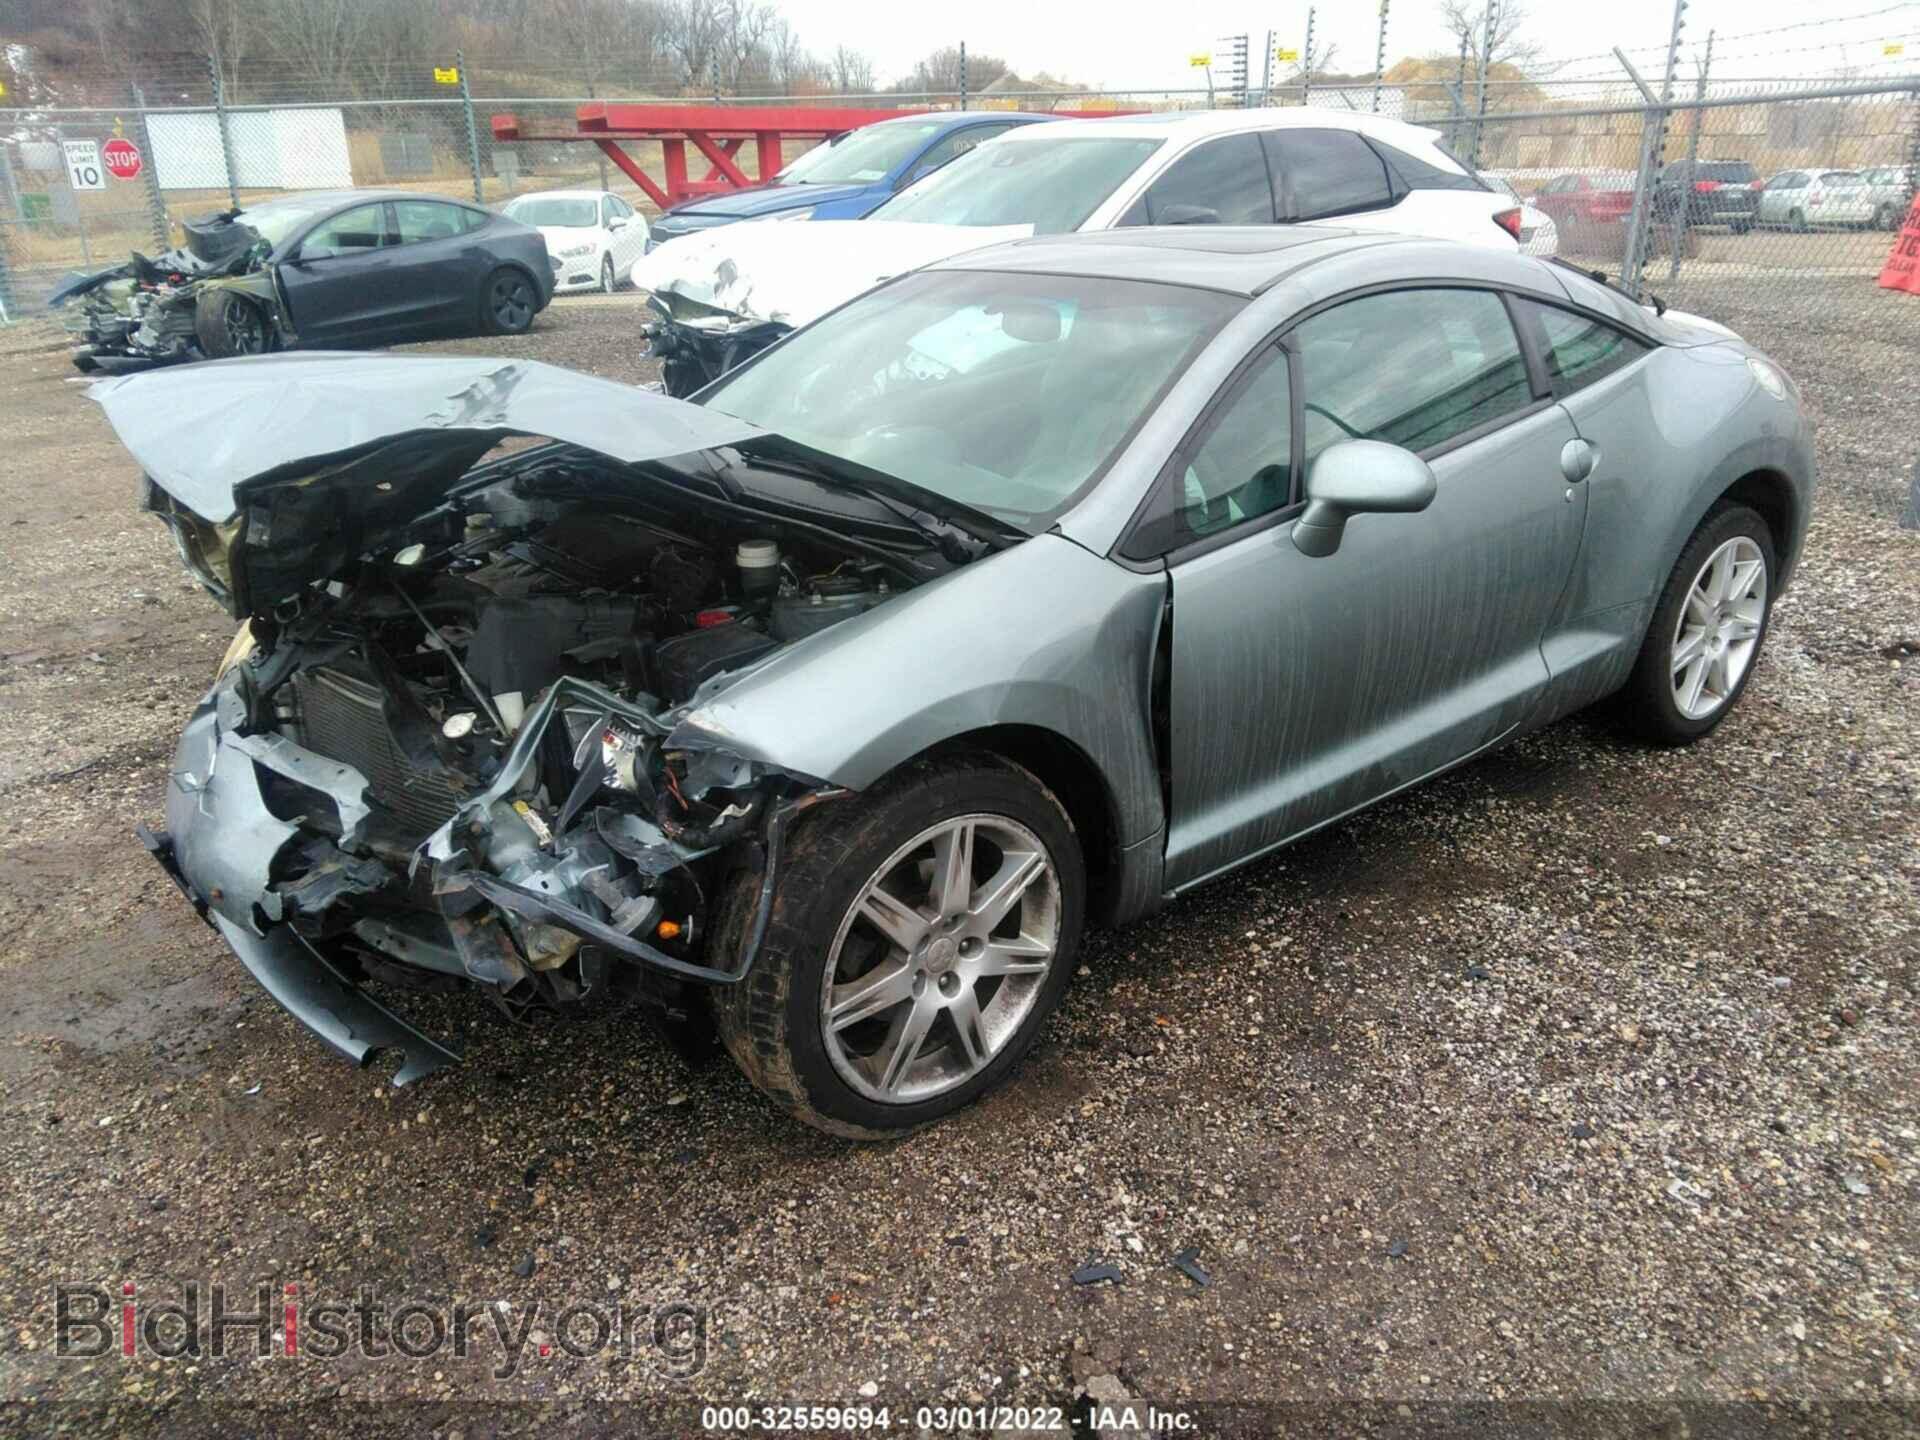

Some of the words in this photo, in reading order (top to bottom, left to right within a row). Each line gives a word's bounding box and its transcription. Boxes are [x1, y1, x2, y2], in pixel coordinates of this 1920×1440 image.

[64, 143, 96, 153] SPEED
[71, 155, 95, 164] LIMIT
[104, 151, 138, 168] STOP
[73, 167, 98, 185] 10
